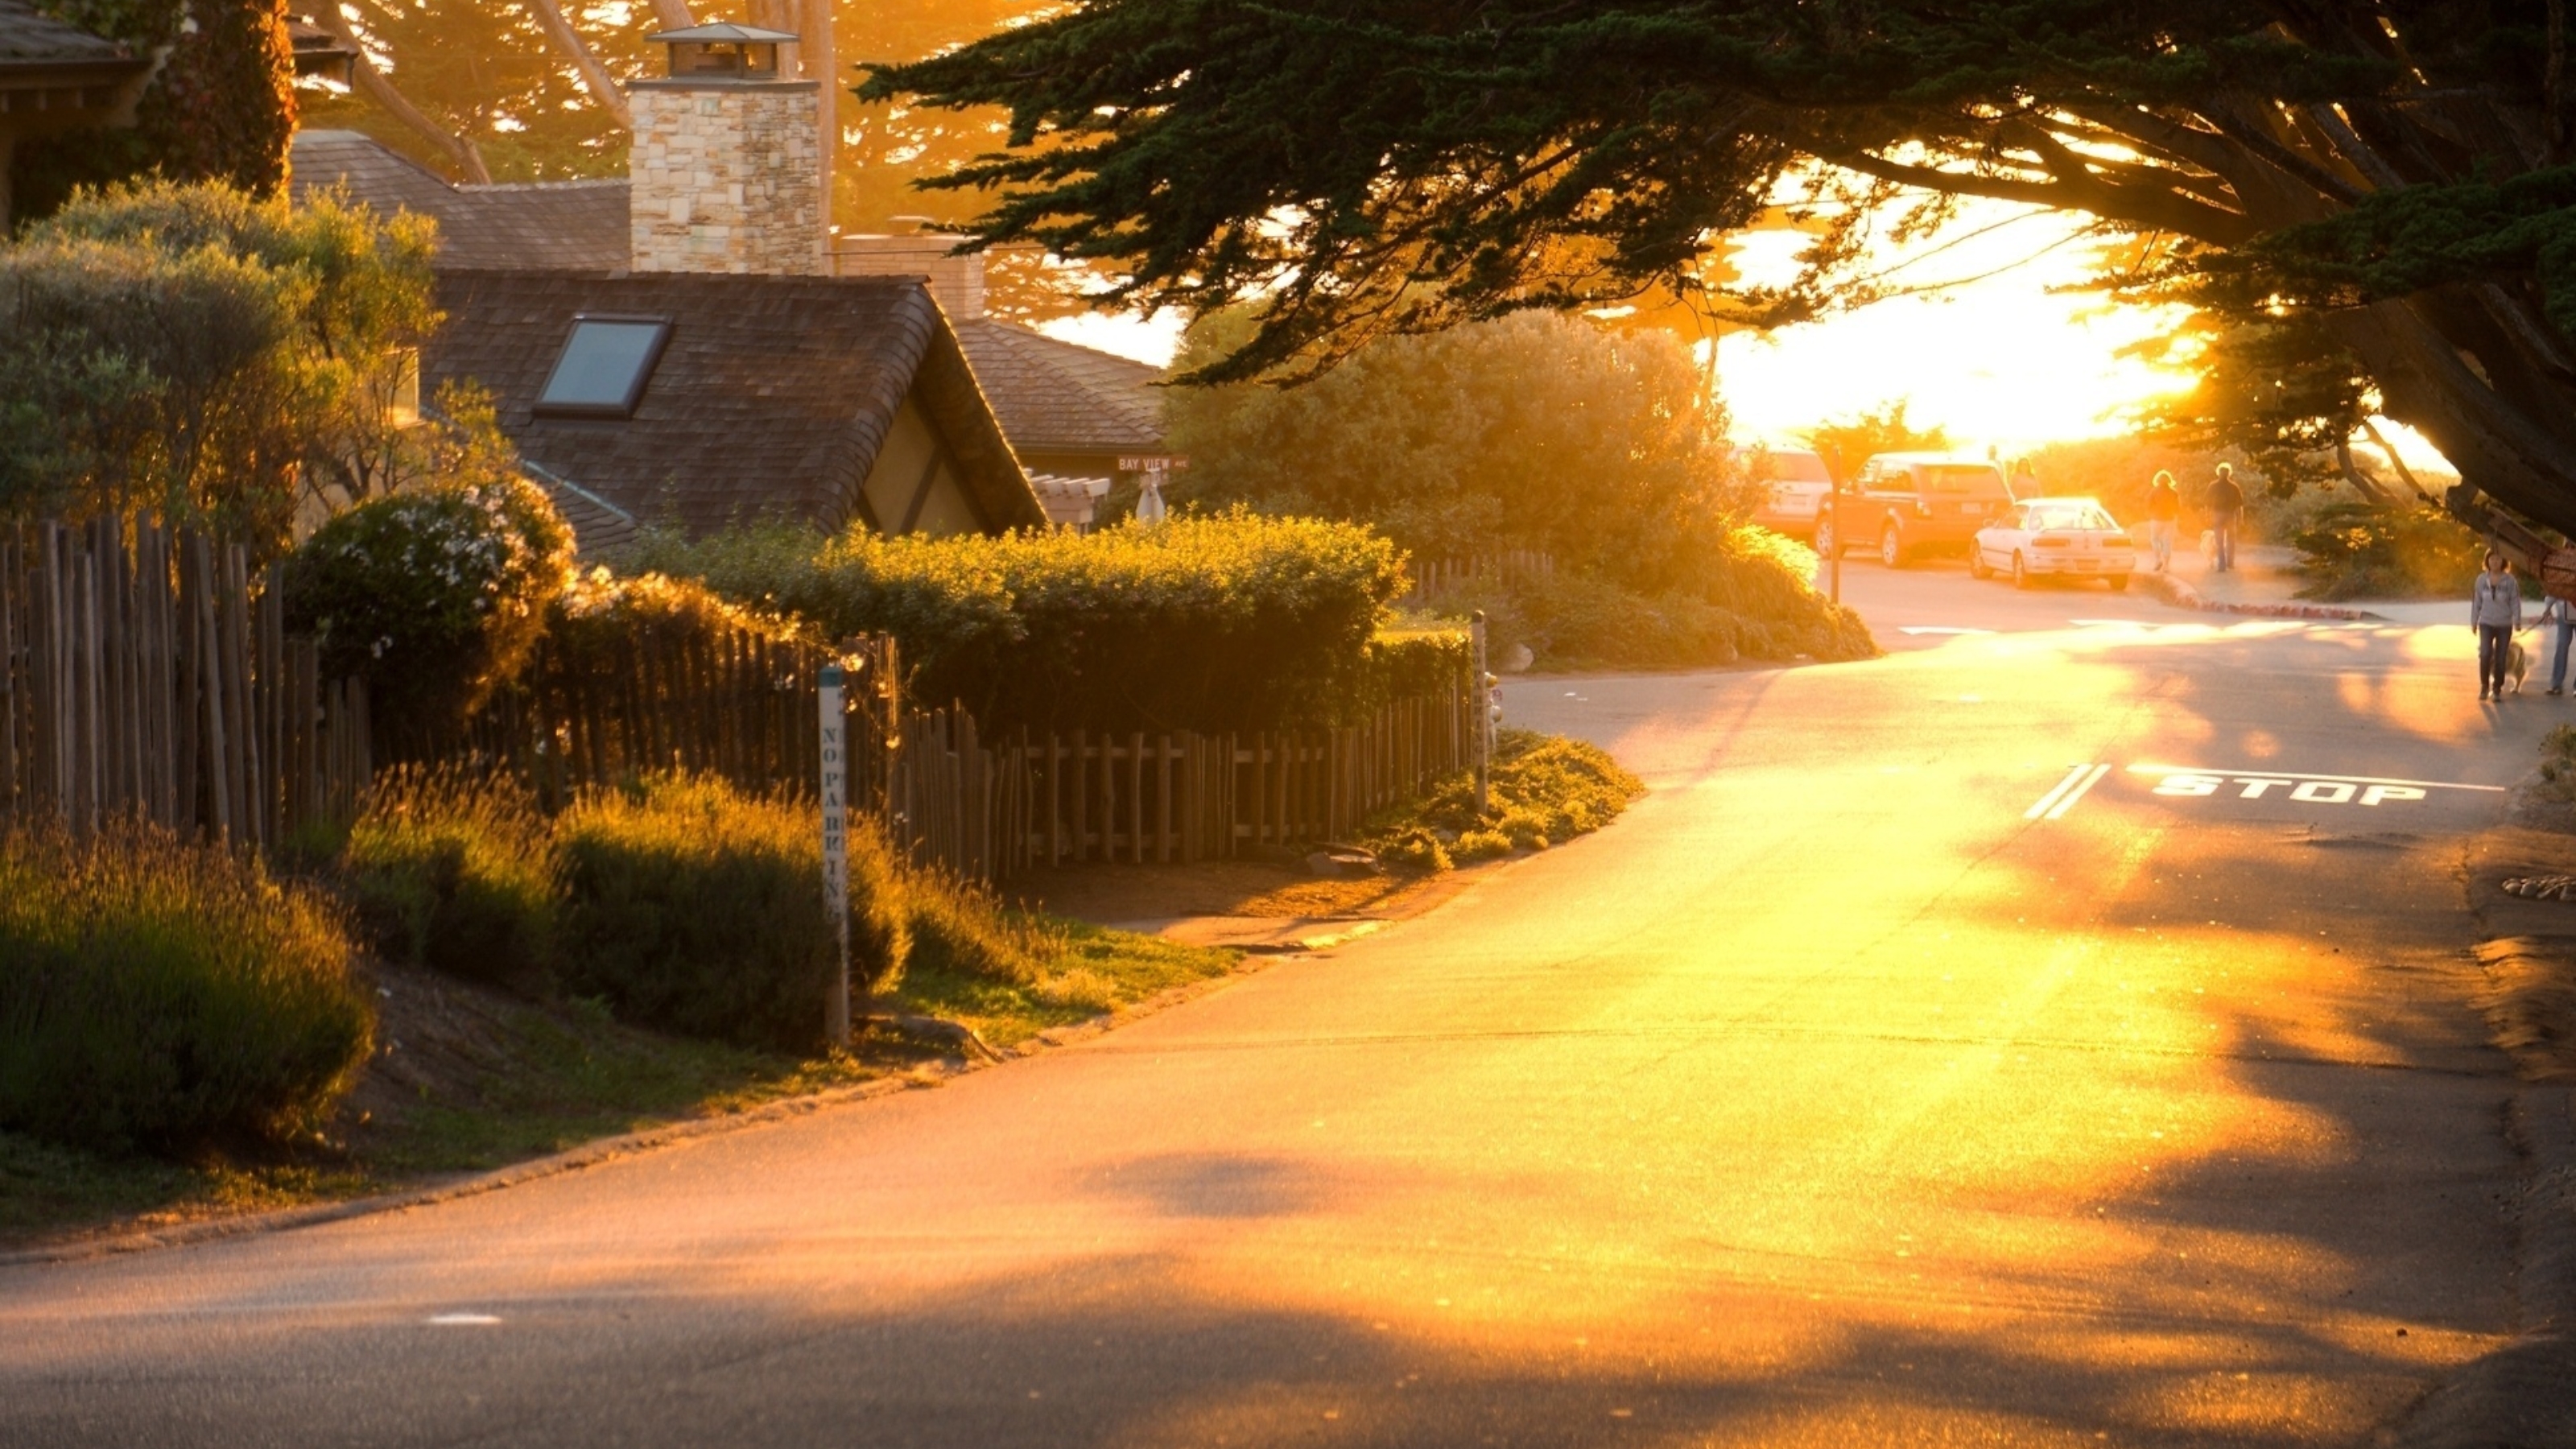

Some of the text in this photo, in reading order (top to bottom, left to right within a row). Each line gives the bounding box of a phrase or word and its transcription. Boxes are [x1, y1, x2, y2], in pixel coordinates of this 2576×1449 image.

[1119, 458, 1138, 470] BAY
[1143, 458, 1169, 471] VIEW
[1472, 645, 1483, 754] NO PARKING
[823, 727, 837, 763] NO
[2152, 774, 2426, 806] STOP
